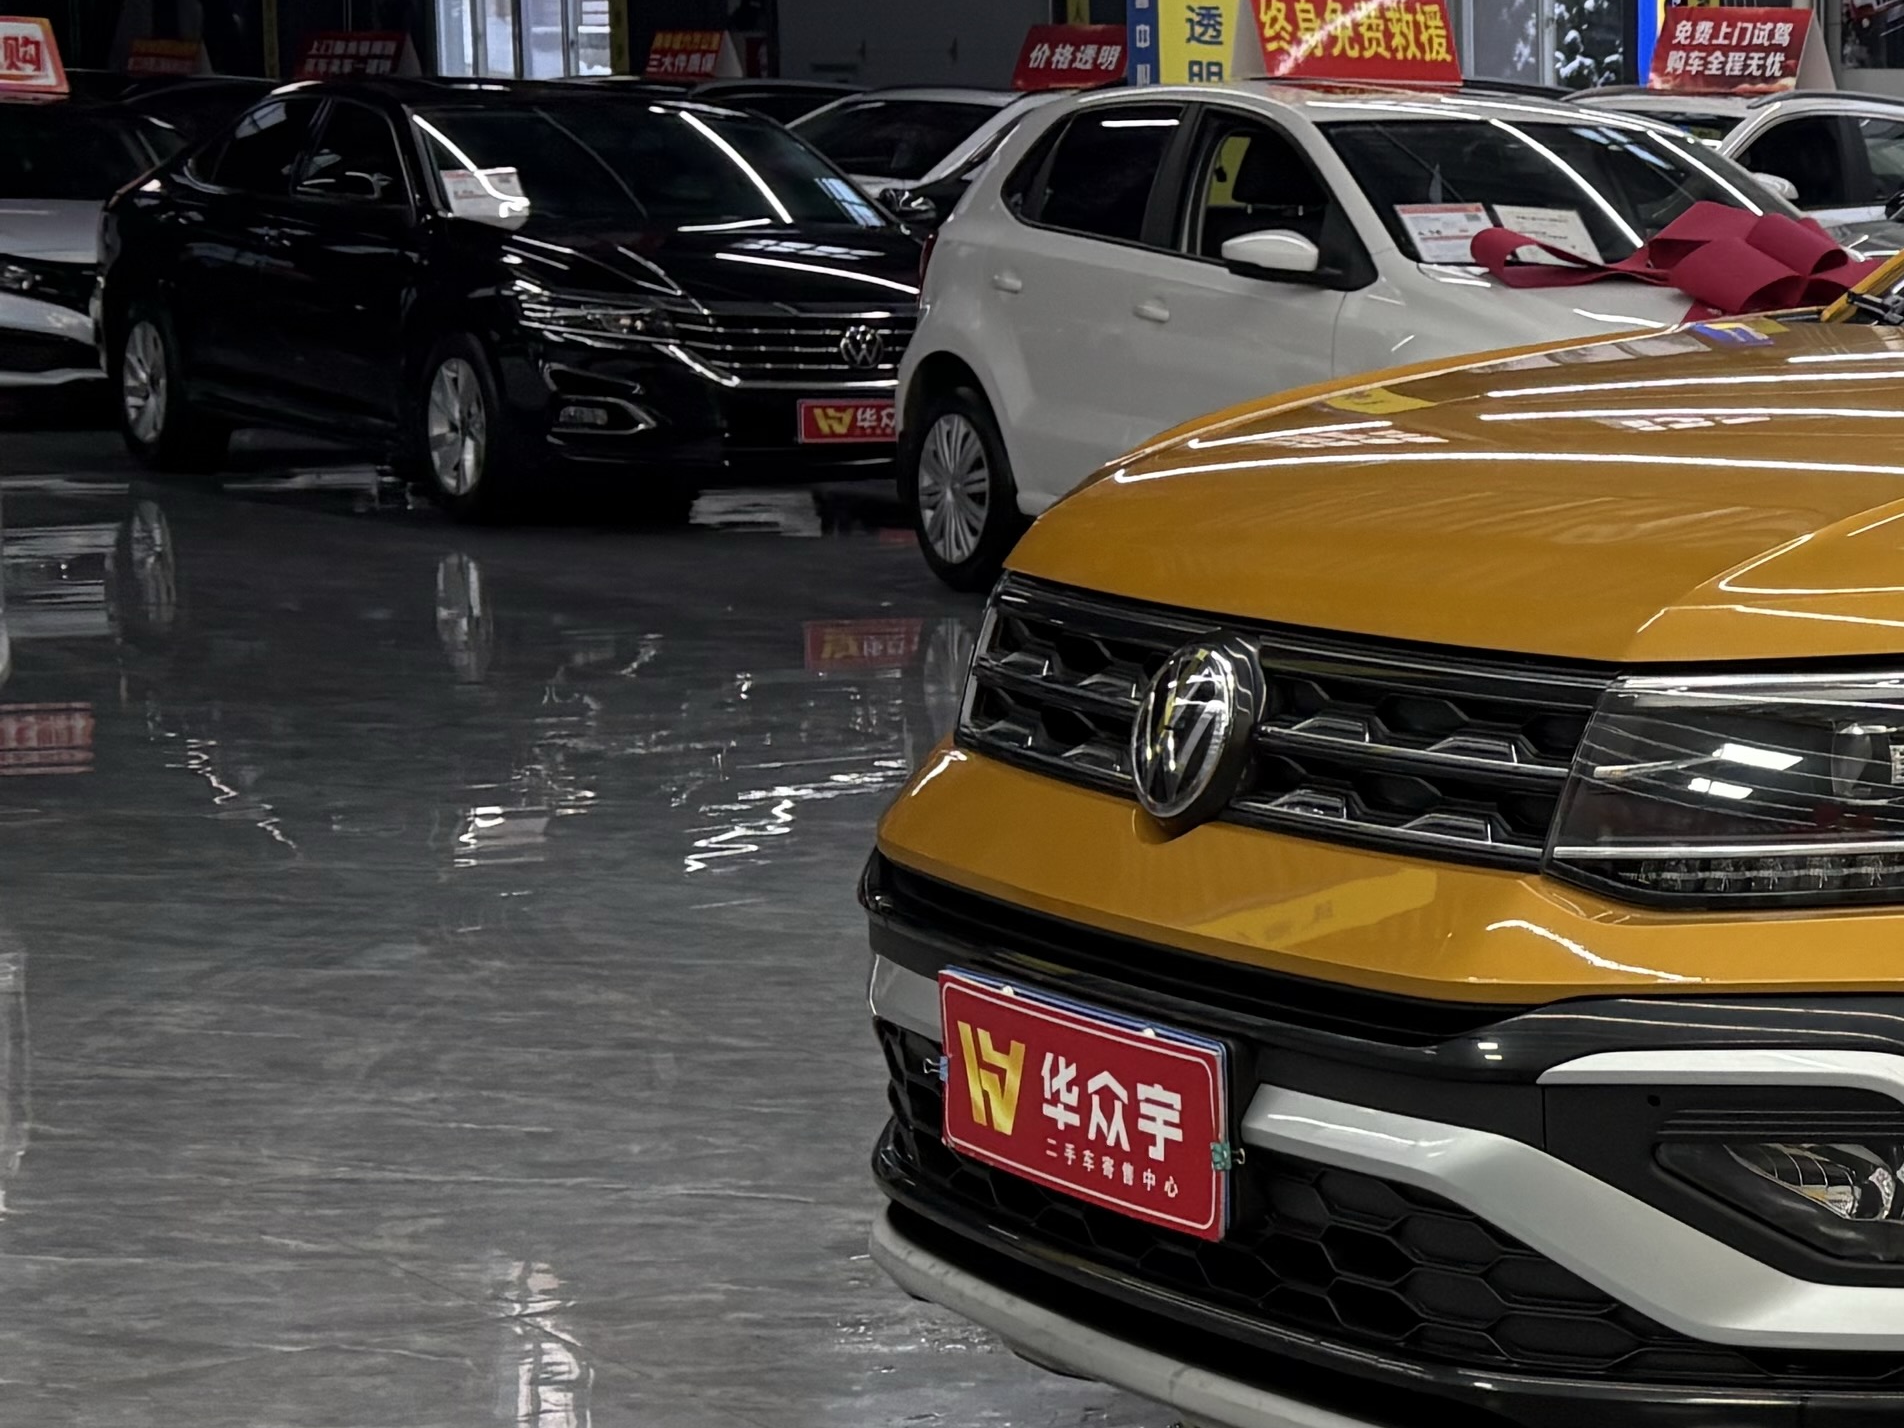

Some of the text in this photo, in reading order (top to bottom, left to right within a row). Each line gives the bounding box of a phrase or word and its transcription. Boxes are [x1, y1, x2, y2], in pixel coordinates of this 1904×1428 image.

[1672, 19, 1794, 47] 免费上门试驾
[1028, 42, 1122, 71] 价格透明
[1041, 1051, 1183, 1163] 华众宇
[1046, 1137, 1179, 1198] 二手车寄售中心
